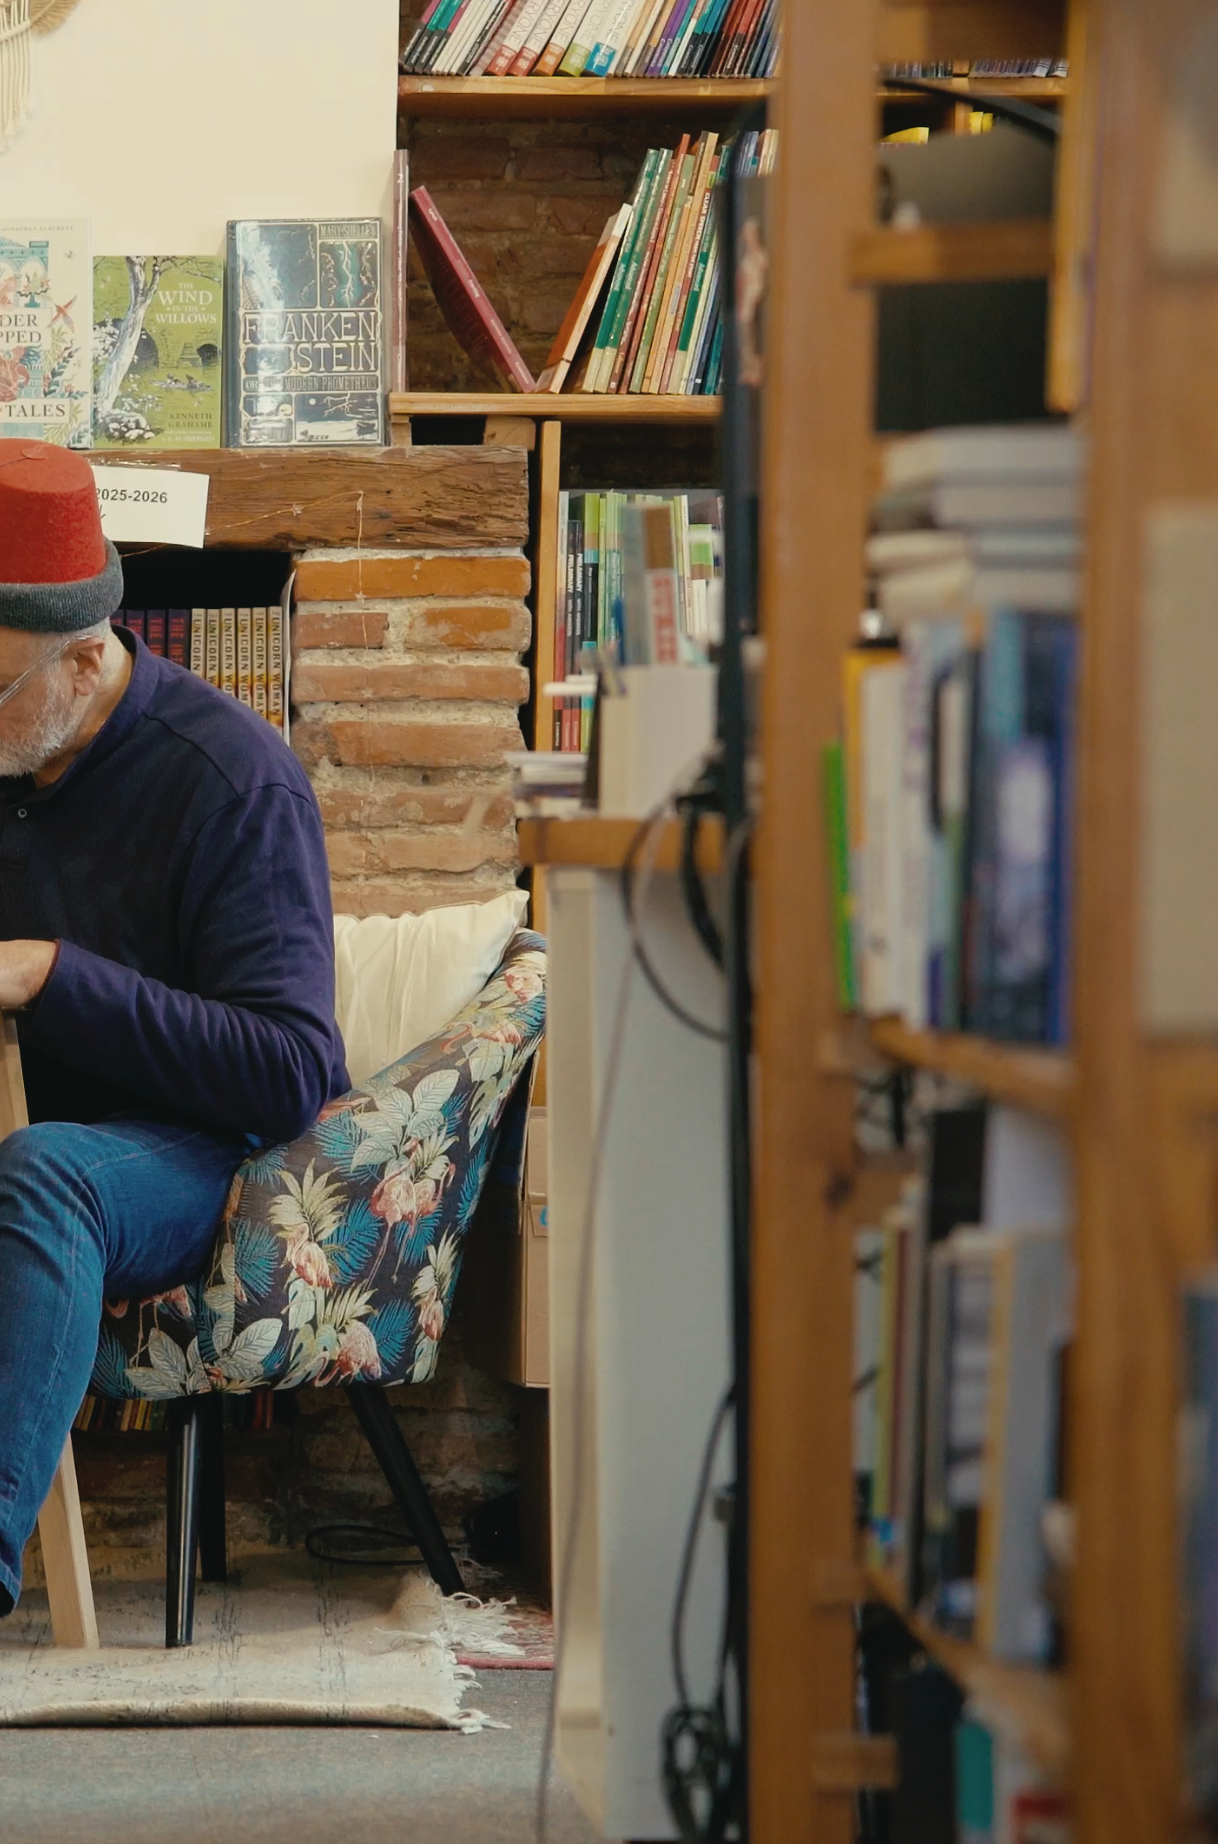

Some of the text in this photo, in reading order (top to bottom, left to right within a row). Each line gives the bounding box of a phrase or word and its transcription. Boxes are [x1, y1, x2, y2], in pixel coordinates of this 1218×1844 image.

[158, 290, 213, 306] WIND
[155, 313, 217, 324] WILLOWS
[243, 311, 376, 343] FRANKEN
[296, 342, 376, 373] STEIN
[284, 376, 319, 391] MODERN
[322, 375, 377, 390] PROMETHEUS
[5, 404, 66, 418] TALES
[149, 619, 163, 638] THE
[169, 618, 183, 638] THE
[224, 618, 233, 670] UNICORN
[256, 617, 264, 669] UNICORN
[272, 617, 281, 669] UNICORN
[193, 619, 202, 671] UNICORN
[208, 619, 217, 671] UNICORN
[240, 618, 249, 671] UNICORN
[272, 673, 281, 716] WOMAN
